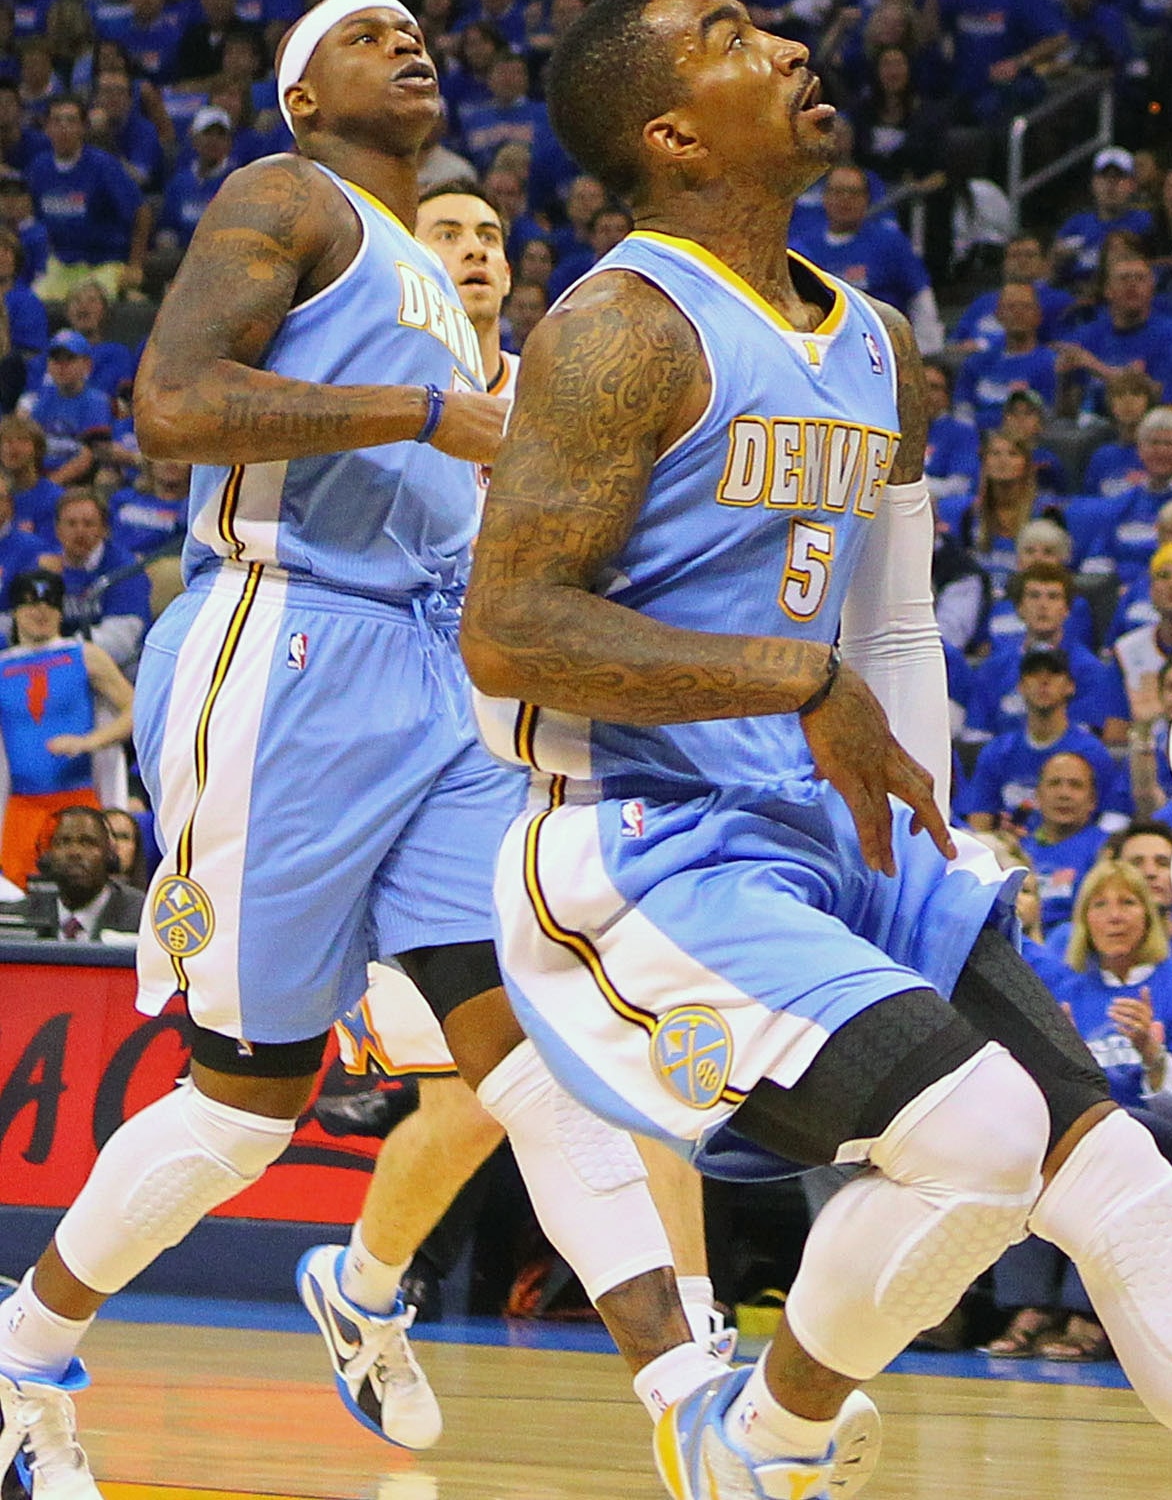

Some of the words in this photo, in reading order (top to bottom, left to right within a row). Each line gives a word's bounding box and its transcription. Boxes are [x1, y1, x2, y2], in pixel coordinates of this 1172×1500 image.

[395, 259, 487, 392] DENV
[715, 414, 903, 520] DENVE
[776, 514, 836, 624] 5
